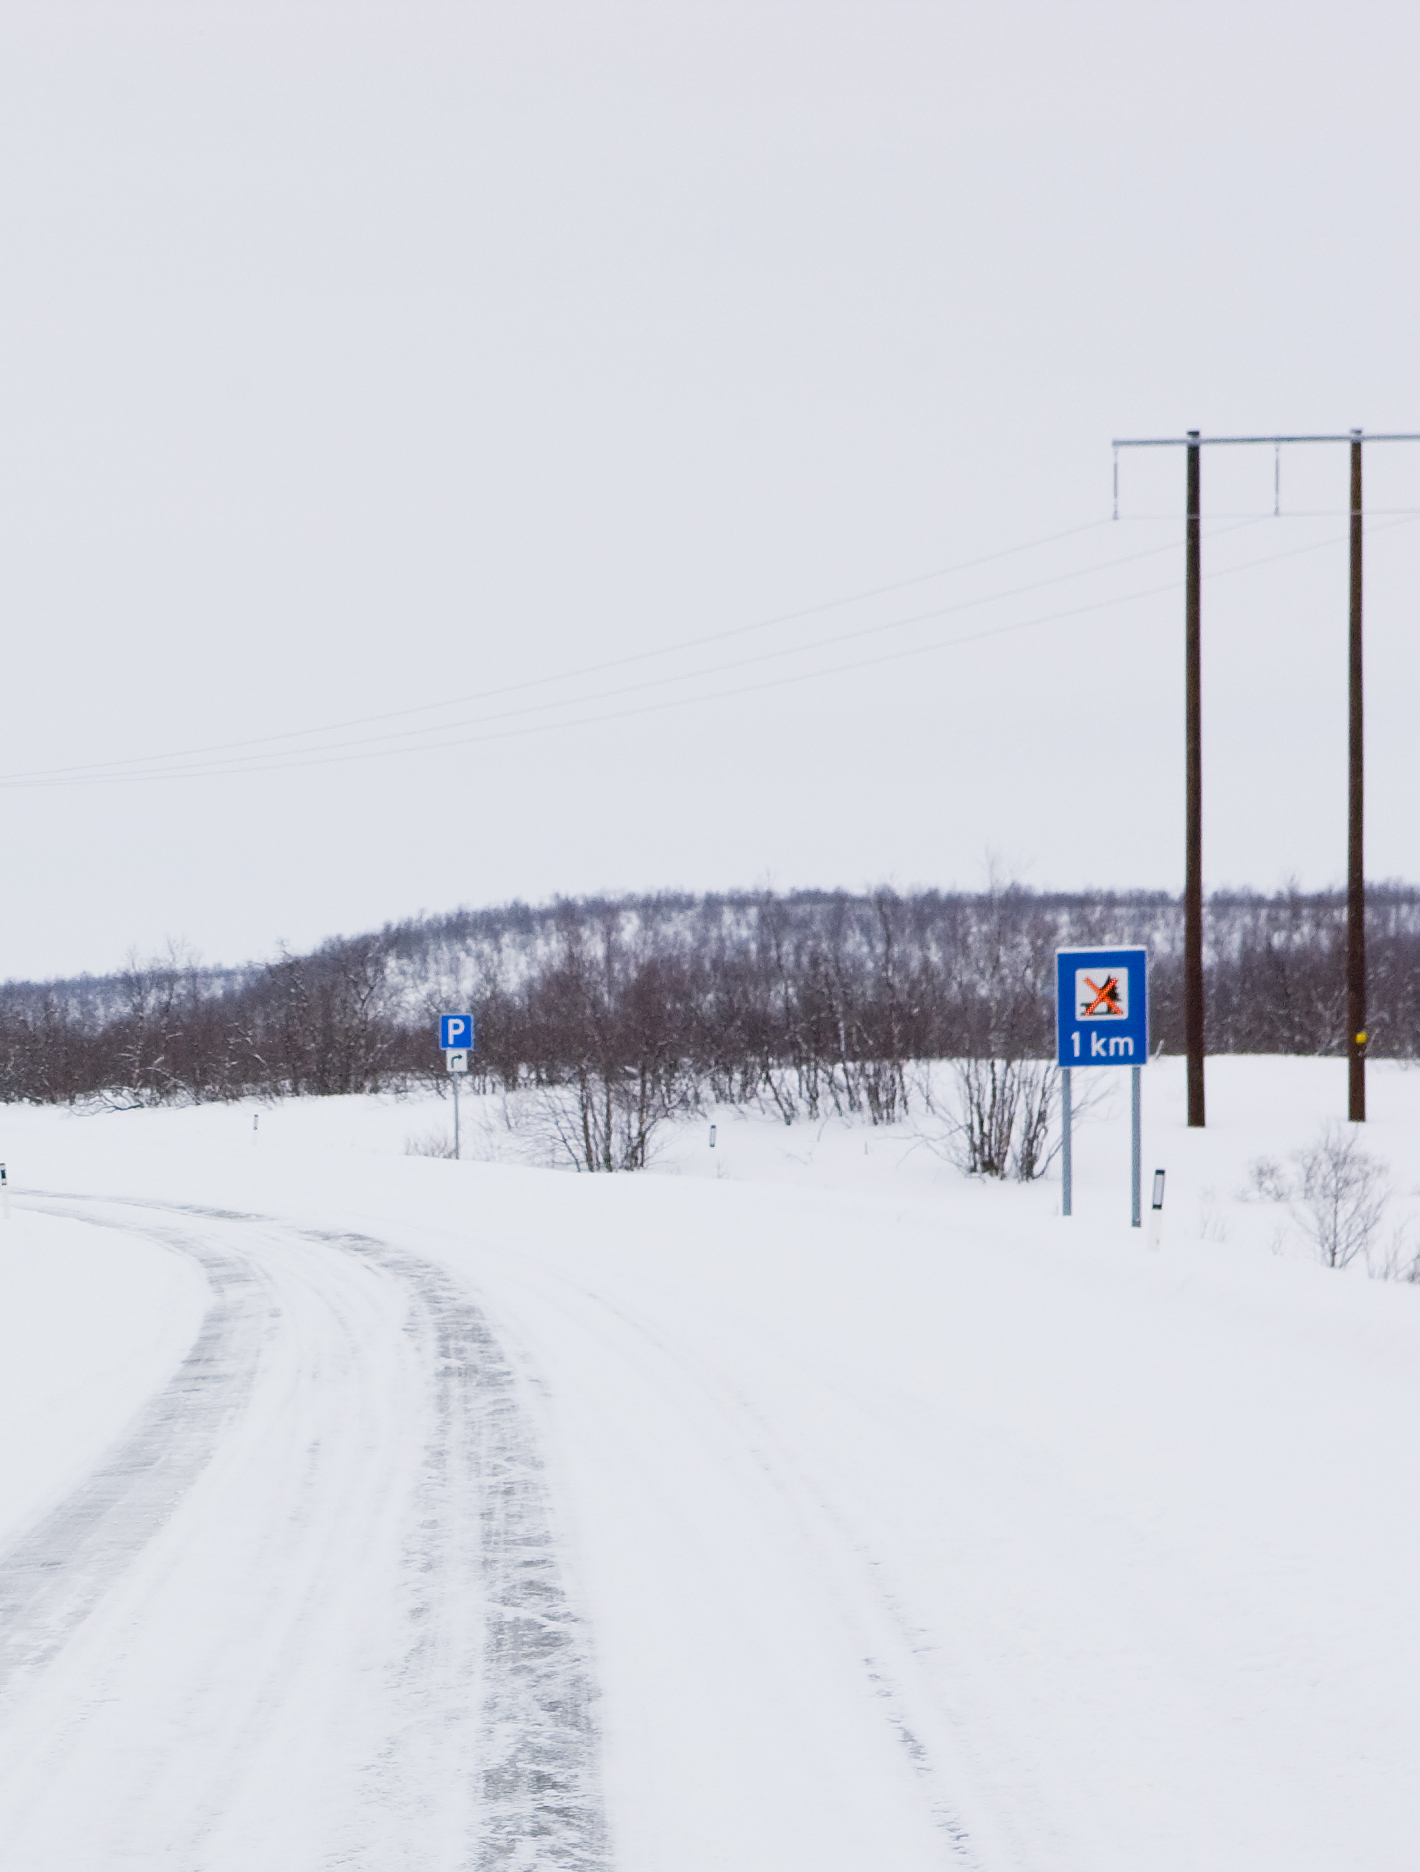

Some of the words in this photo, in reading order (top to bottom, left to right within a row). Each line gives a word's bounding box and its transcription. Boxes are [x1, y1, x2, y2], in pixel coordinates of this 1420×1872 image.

[447, 1018, 465, 1045] P
[1071, 1031, 1080, 1057] 1
[1091, 1031, 1134, 1057] km
